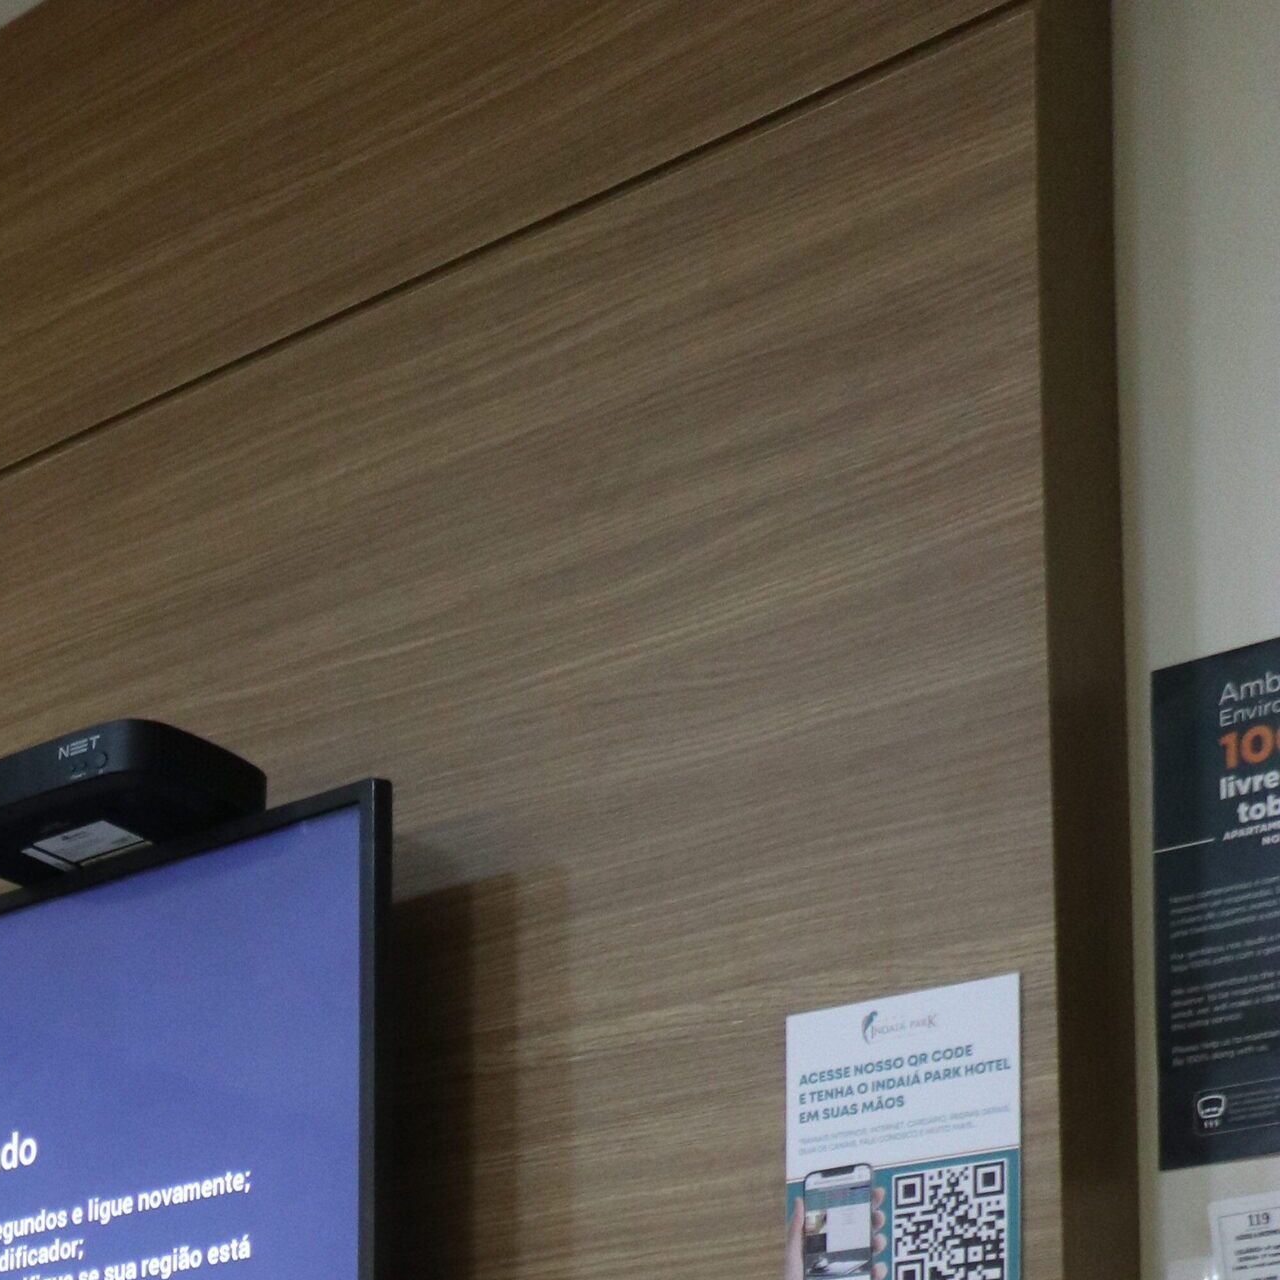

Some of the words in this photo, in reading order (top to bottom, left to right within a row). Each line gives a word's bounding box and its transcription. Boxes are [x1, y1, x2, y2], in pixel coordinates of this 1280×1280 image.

[58, 735, 100, 760] NET
[1219, 724, 1280, 770] 10
[798, 1065, 851, 1086] ACESSE
[853, 1056, 904, 1076] NOSSO
[906, 1052, 928, 1066] QR
[930, 1043, 973, 1062] CODE
[798, 1092, 806, 1105] E
[808, 1084, 855, 1103] TENHA
[856, 1082, 868, 1094] O
[871, 1070, 922, 1092] INDAIÁ
[923, 1065, 962, 1083] PARK
[964, 1057, 1011, 1077] HOTEL
[798, 1109, 819, 1124] EM
[821, 1102, 859, 1120] SUAS
[860, 1094, 905, 1114] MÃOS
[71, 1206, 83, 1224] e
[87, 1195, 133, 1224] ligue
[137, 1170, 250, 1211] novamente;
[1248, 1212, 1270, 1227] 119
[140, 1244, 202, 1279] região
[207, 1233, 251, 1264] está
